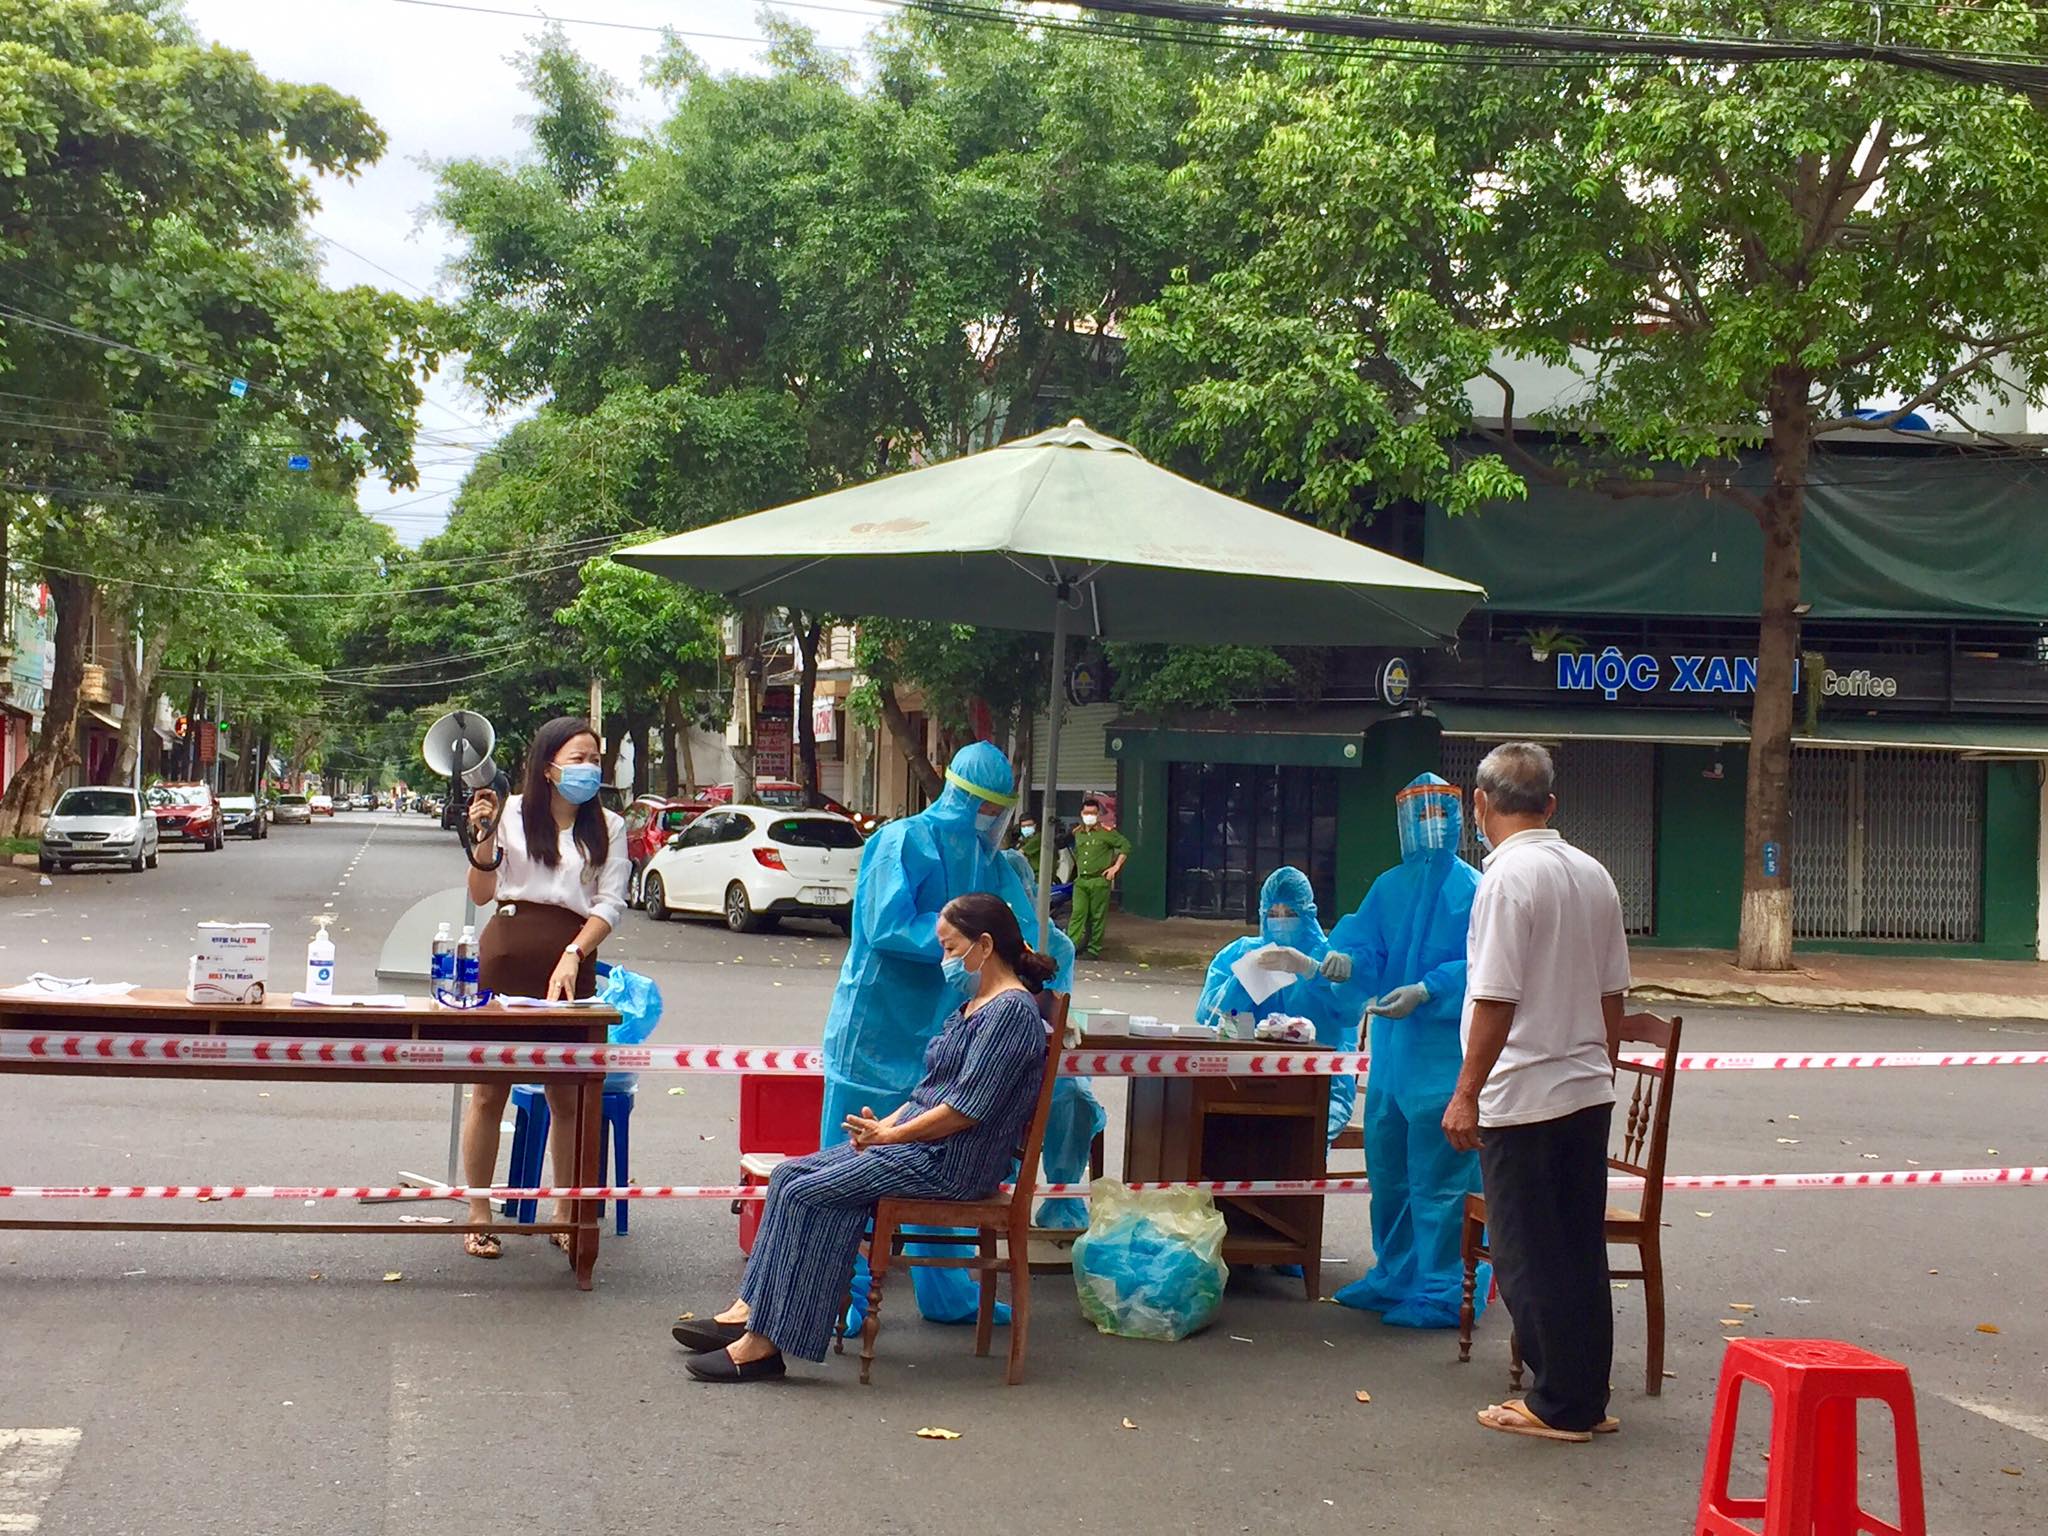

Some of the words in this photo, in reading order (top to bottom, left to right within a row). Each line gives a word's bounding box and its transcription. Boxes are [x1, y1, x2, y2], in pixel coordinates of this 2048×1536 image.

[1556, 646, 1660, 701] MỘC
[1669, 655, 1800, 694] XAN
[1820, 669, 1897, 697] Coffee
[224, 972, 236, 980] Pro
[236, 972, 254, 980] Mask
